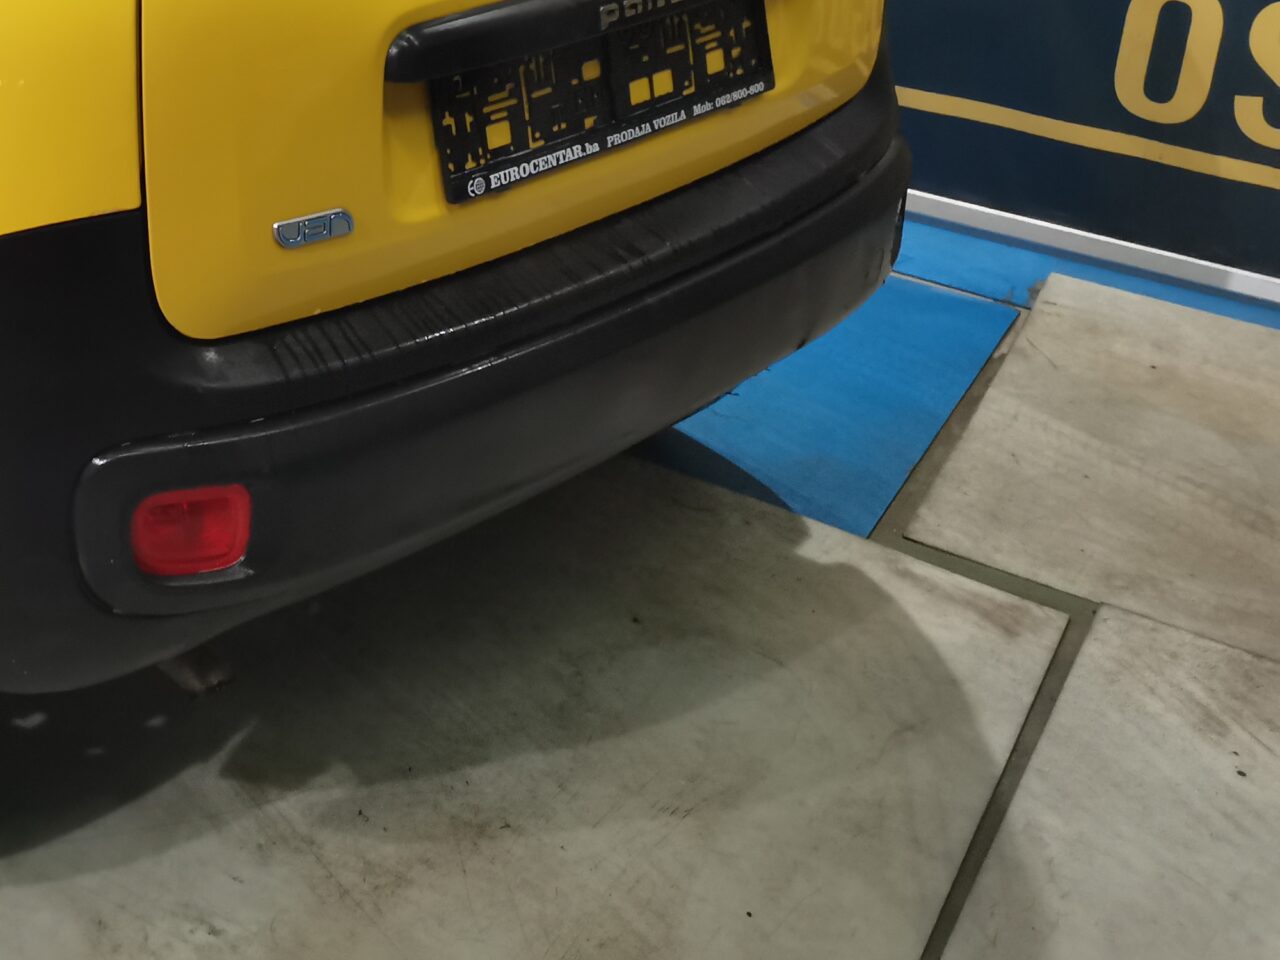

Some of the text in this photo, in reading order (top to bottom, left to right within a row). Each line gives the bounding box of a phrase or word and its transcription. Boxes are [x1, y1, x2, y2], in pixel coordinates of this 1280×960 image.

[489, 142, 600, 189] EUROCENTAR.ba
[606, 122, 652, 148] PRODAJA
[652, 109, 686, 129] VOZILA
